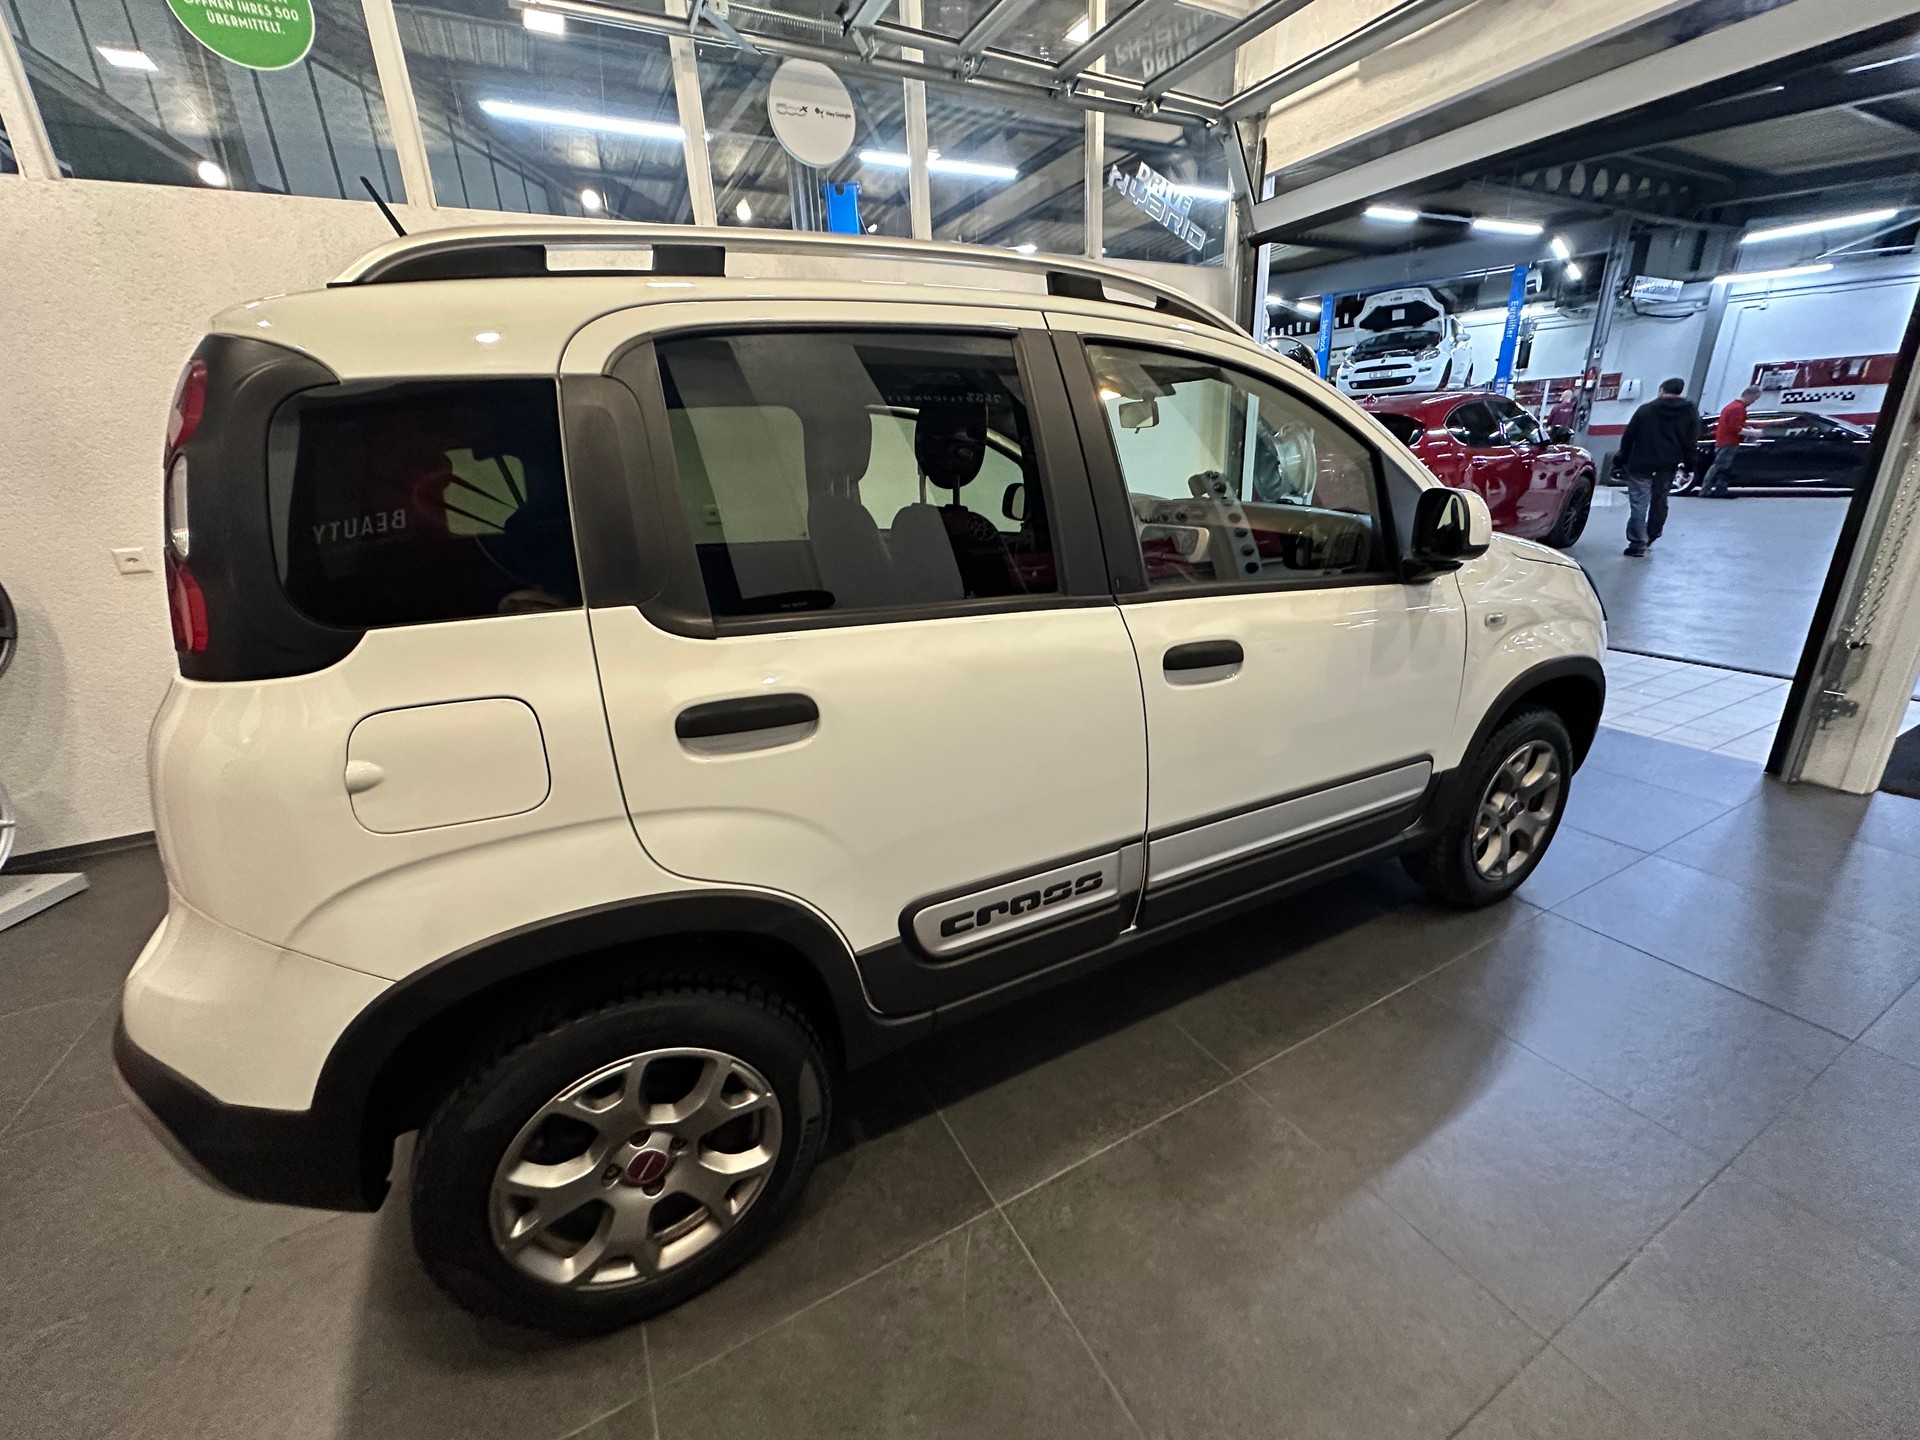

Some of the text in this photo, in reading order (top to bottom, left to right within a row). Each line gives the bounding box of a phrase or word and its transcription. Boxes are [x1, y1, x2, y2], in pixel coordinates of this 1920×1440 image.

[183, 0, 300, 21] FNEN IHRES 500
[1136, 161, 1194, 212] DRIVE
[1319, 319, 1329, 353] Steinbock
[1506, 300, 1520, 339] Eurolifter
